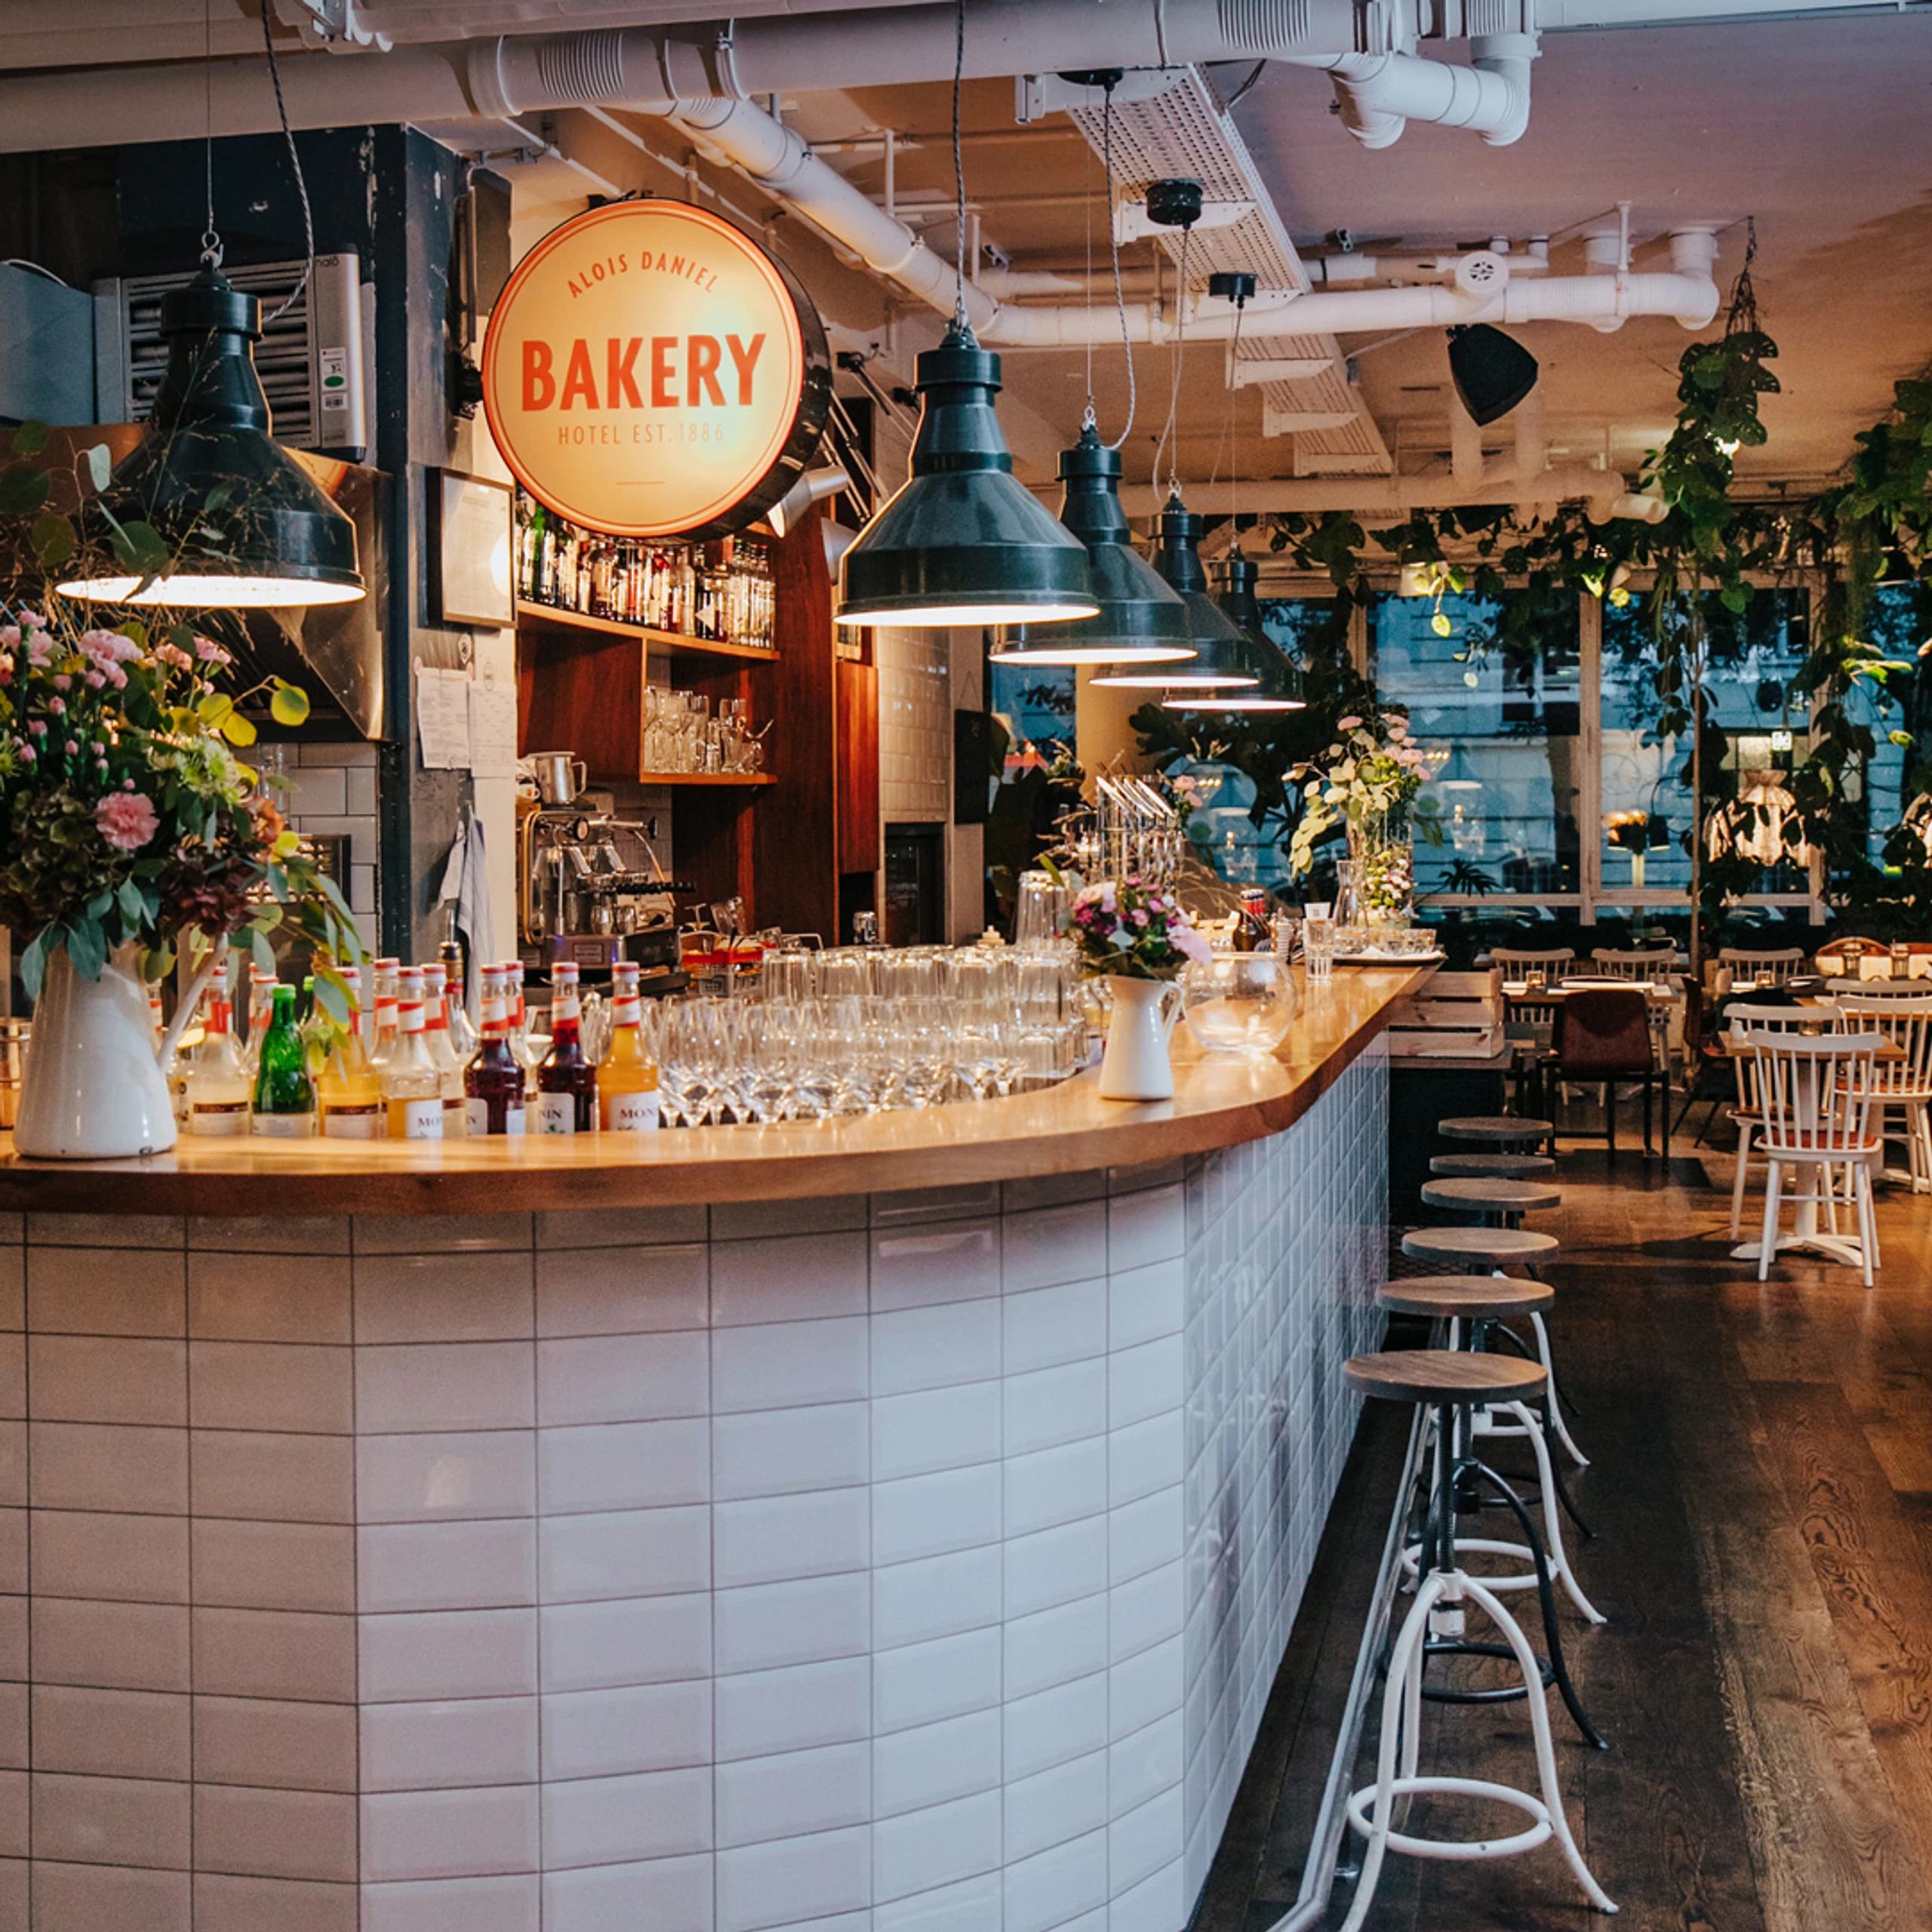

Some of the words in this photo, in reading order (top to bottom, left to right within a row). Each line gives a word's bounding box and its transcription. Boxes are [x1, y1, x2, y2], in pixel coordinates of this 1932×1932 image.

[568, 254, 628, 298] ALOIS
[641, 251, 718, 294] DANIEL
[521, 334, 767, 412] BAKERY
[558, 426, 620, 445] HOTEL
[632, 423, 672, 444] EST.
[678, 422, 724, 442] 1886
